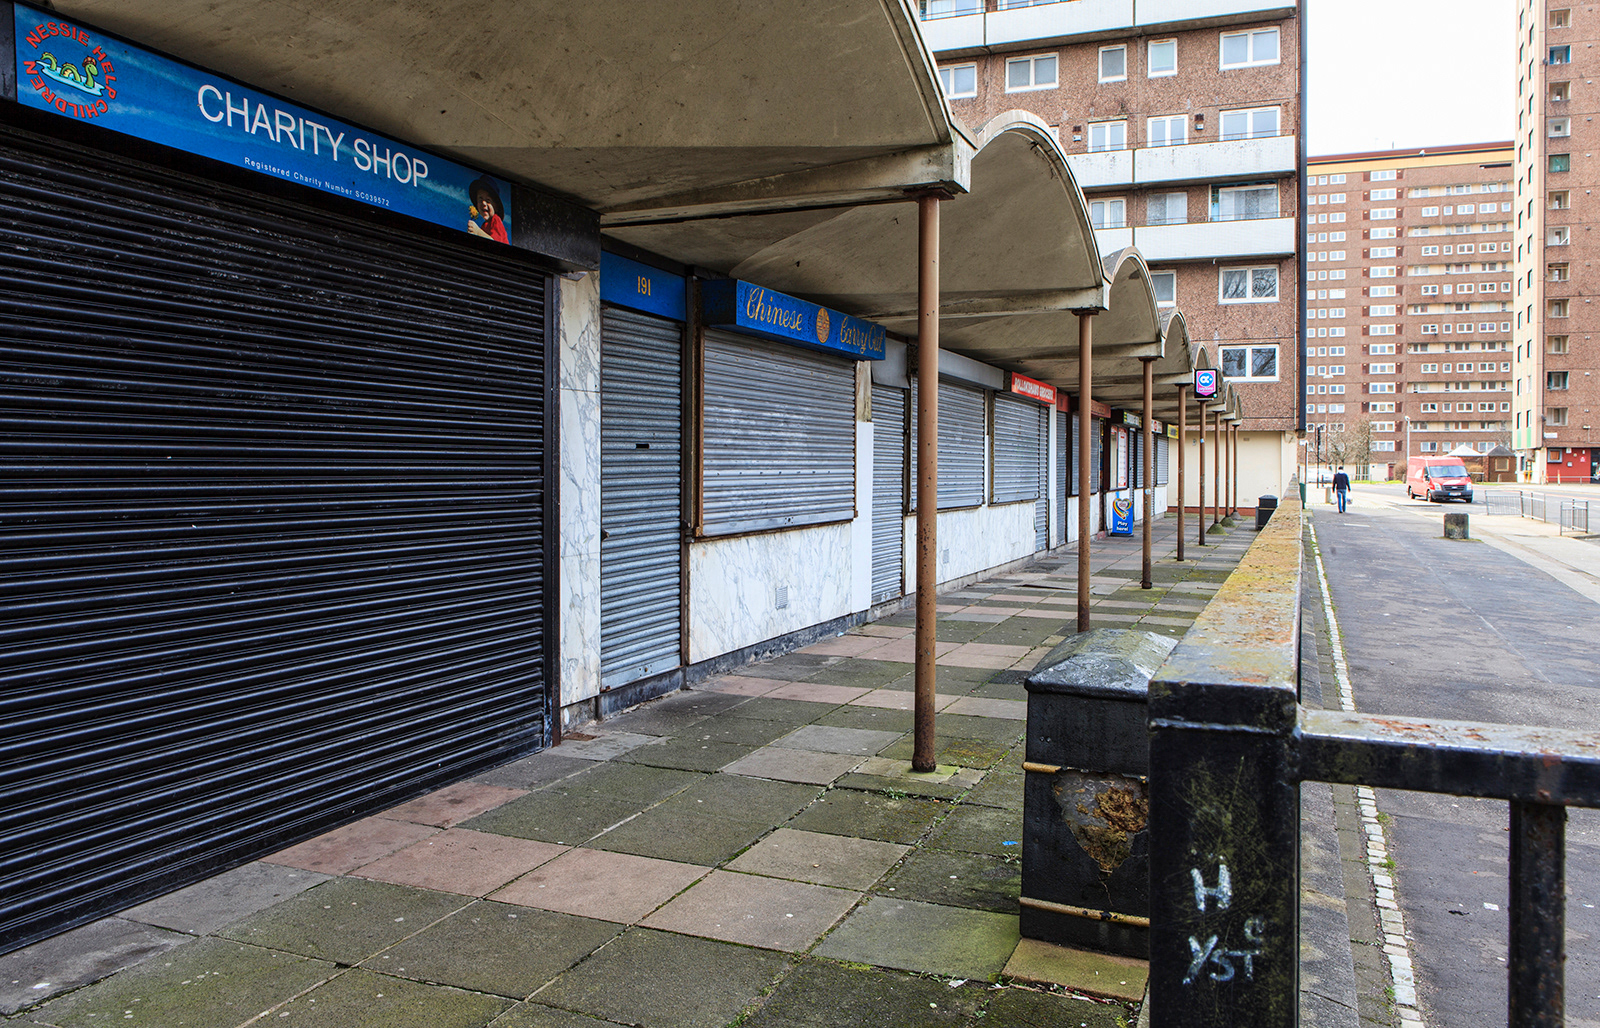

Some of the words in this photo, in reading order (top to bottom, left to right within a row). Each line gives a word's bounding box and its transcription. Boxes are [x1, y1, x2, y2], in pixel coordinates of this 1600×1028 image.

[25, 22, 90, 49] NESSIE
[23, 61, 108, 118] CHILDREN
[92, 45, 117, 100] HELP
[197, 84, 345, 161] CHARITY
[353, 138, 429, 187] SHOP
[244, 156, 291, 177] Registered
[293, 171, 322, 188] Charity
[324, 181, 353, 195] Number
[355, 190, 390, 207] SC039572
[637, 275, 651, 296] 191
[746, 287, 803, 331] Chinese
[840, 316, 868, 354] Carry
[868, 325, 884, 352] Out
[1190, 865, 1232, 911] H
